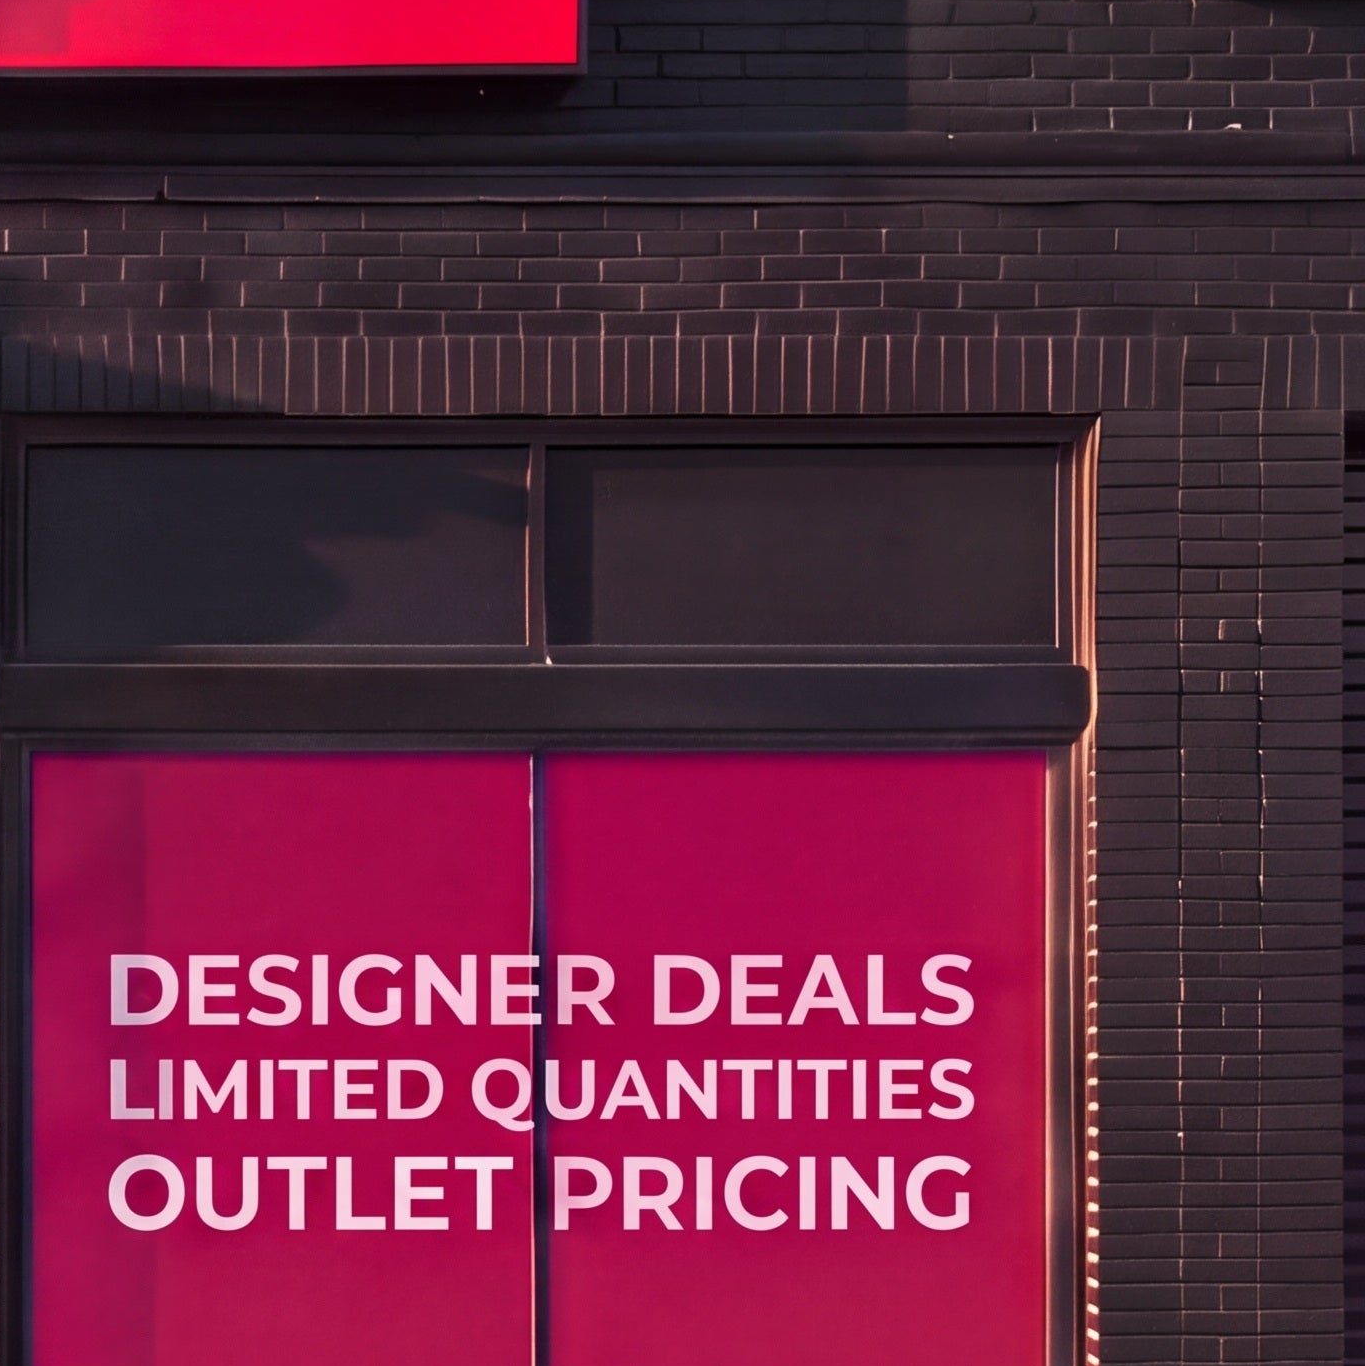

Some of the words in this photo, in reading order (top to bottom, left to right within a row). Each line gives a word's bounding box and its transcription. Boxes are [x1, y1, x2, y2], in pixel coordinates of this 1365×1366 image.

[110, 953, 616, 1027] DESIGNER
[653, 953, 975, 1027] DEALS
[110, 1059, 444, 1120] LIMITED
[471, 1057, 975, 1132] QUANTITIES
[108, 1153, 514, 1232] OUTLET
[554, 1154, 971, 1232] PRICING
